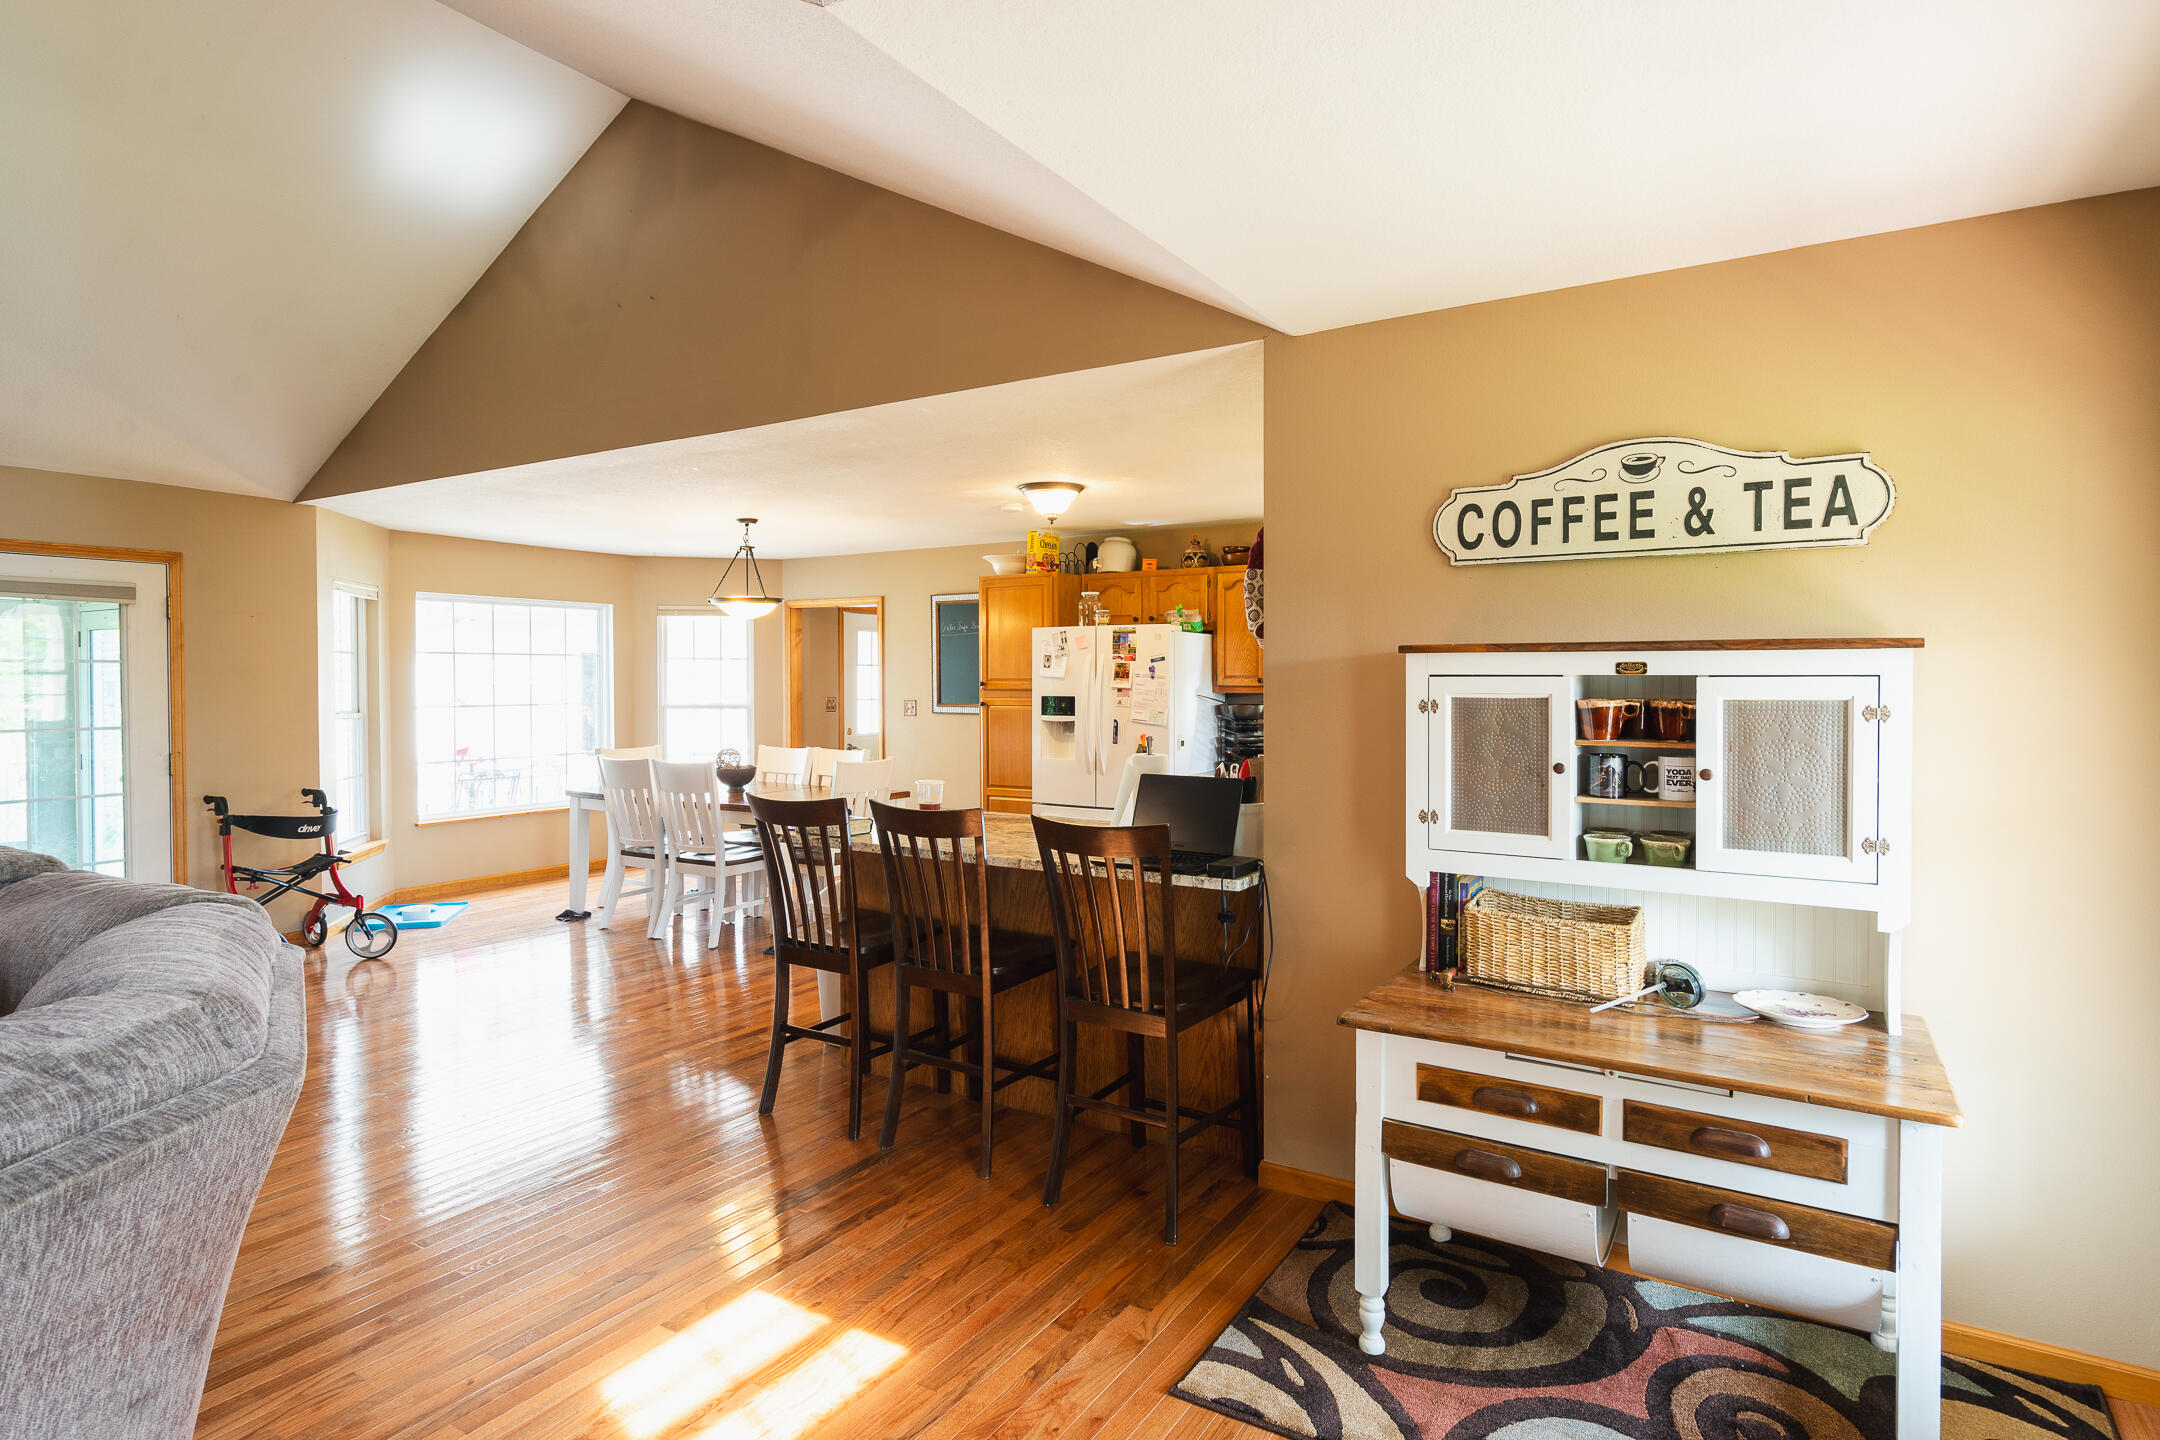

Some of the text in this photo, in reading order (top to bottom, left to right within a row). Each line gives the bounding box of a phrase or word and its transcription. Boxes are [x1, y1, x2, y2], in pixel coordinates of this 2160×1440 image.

[1457, 474, 1859, 550] COFFEE & TEA
[1666, 779, 1692, 787] EVER
[297, 824, 320, 833] drive
